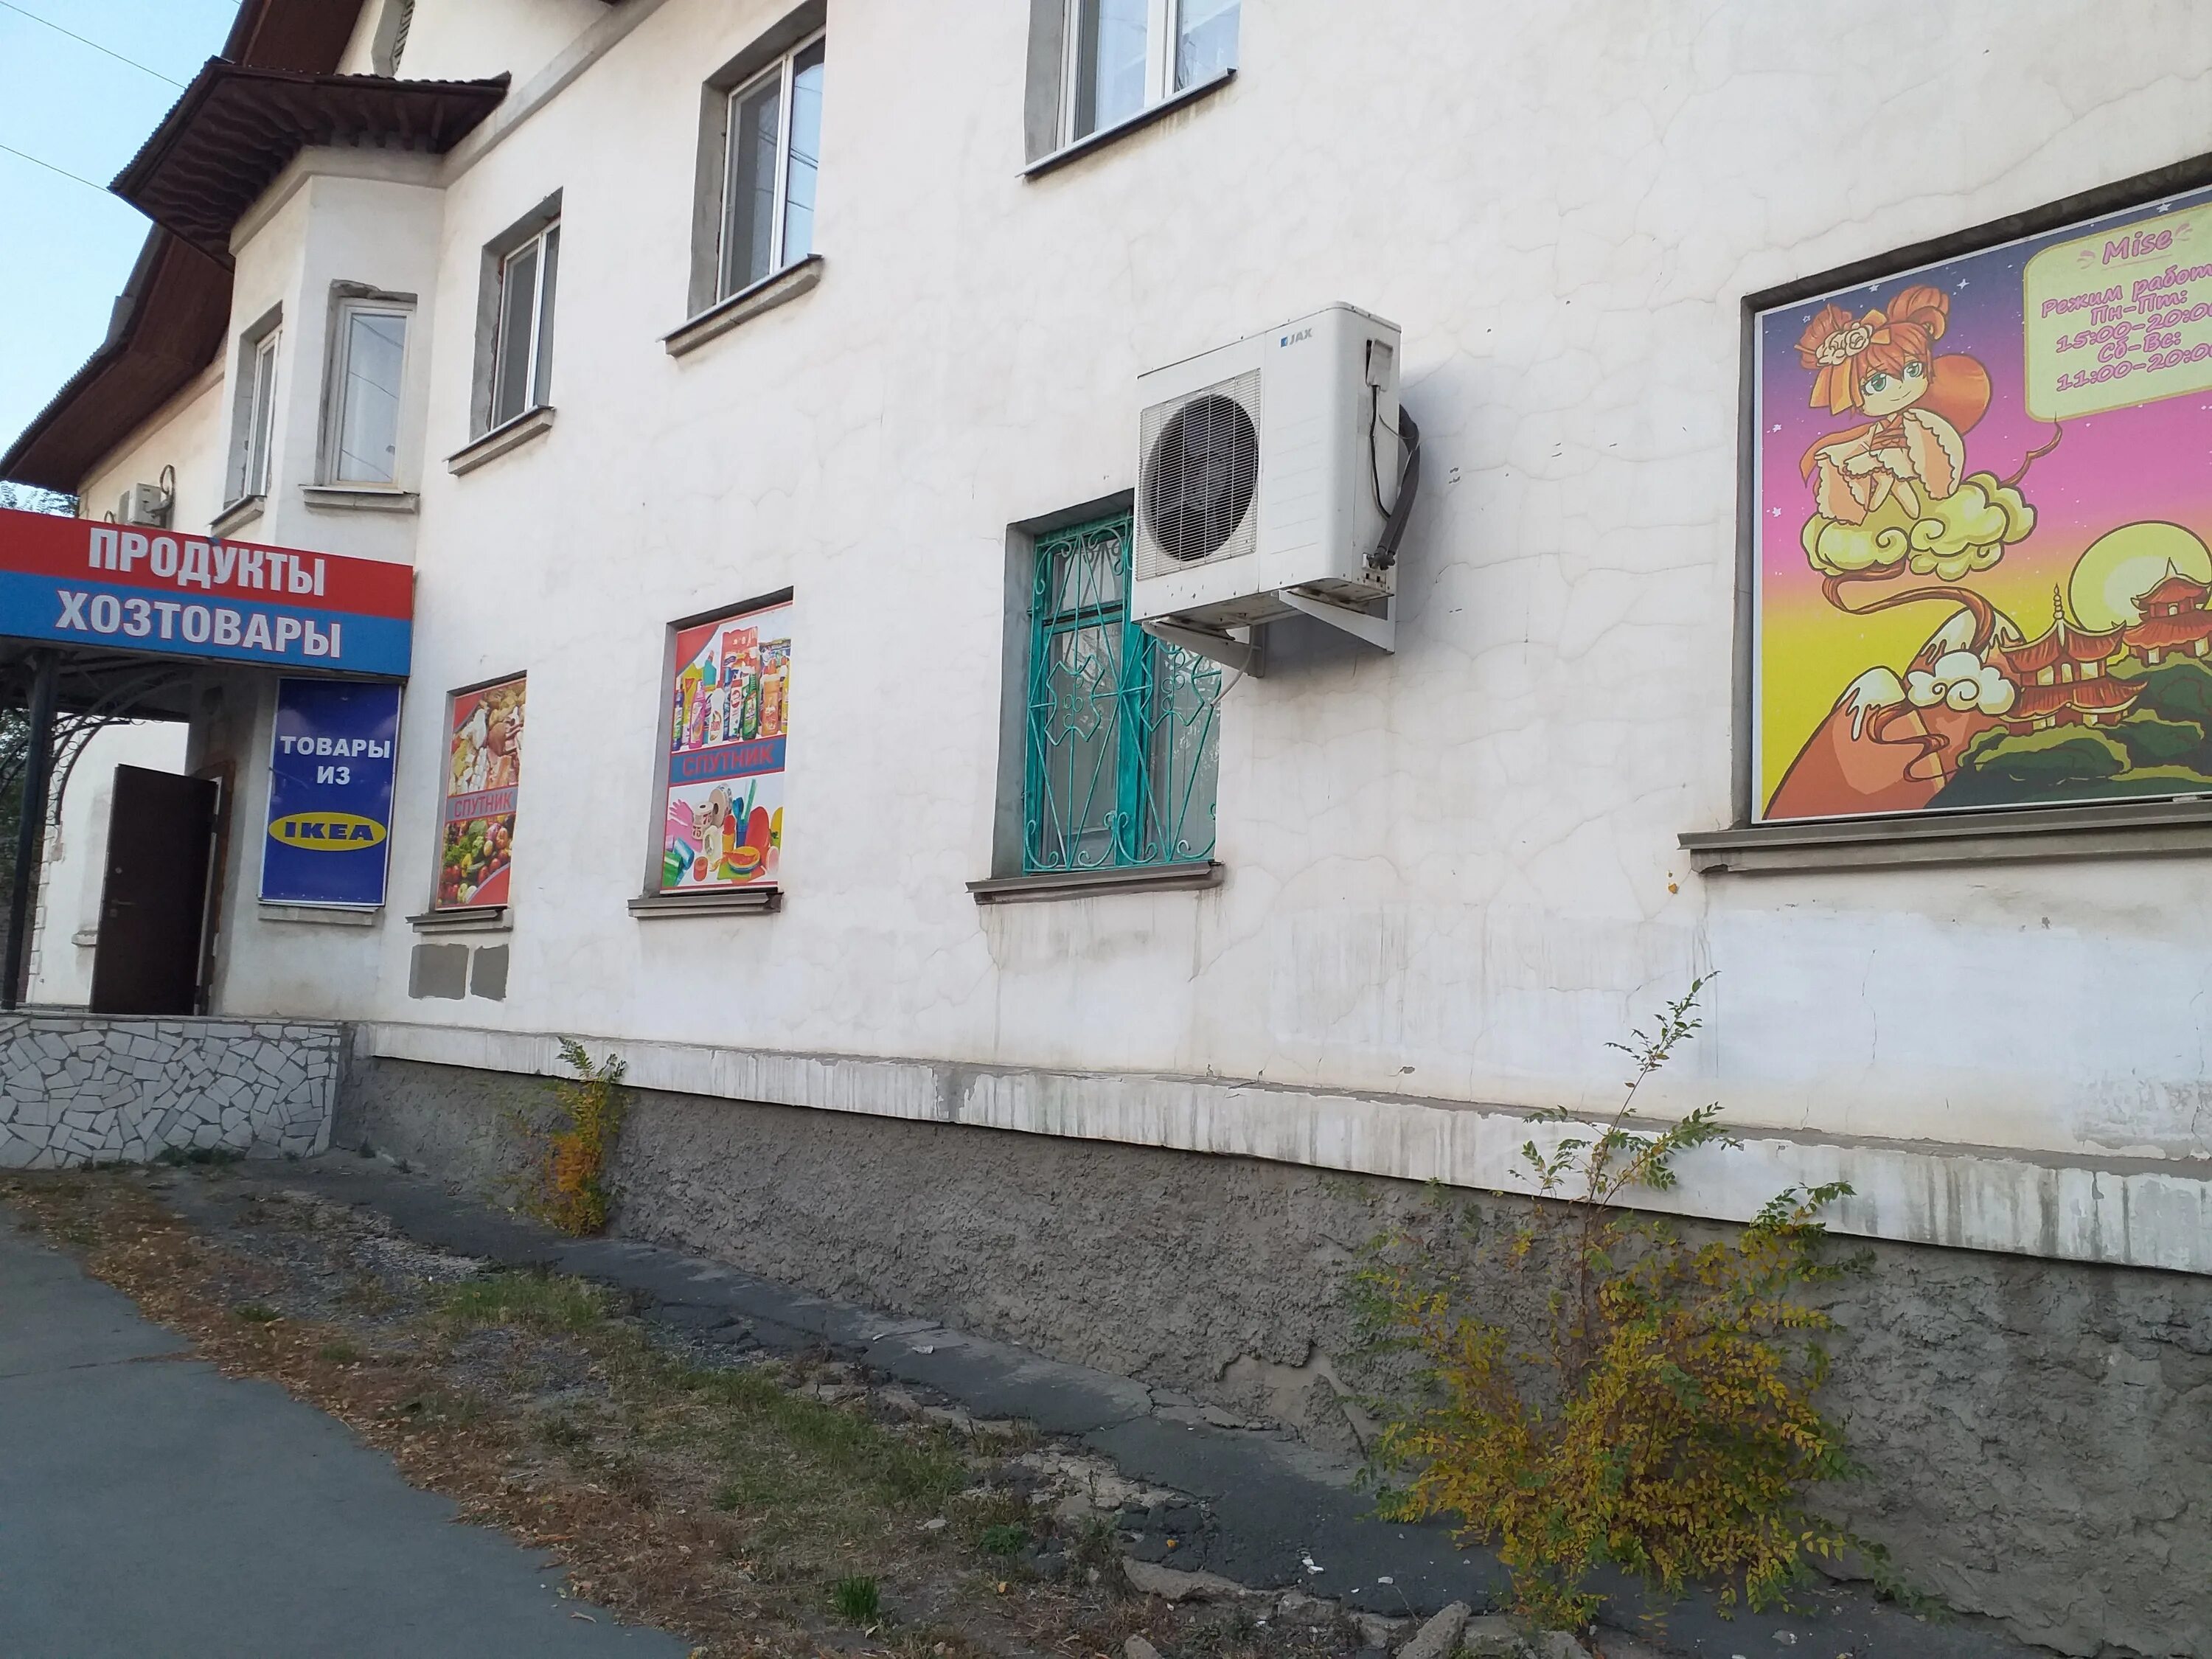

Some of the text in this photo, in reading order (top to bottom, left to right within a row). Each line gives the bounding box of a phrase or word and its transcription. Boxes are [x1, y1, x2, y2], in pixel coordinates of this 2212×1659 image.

[2102, 230, 2173, 265] Mise
[2042, 285, 2124, 319] Режим
[2090, 290, 2188, 326] Пн-Пт:
[1290, 328, 1312, 345] JAX
[2056, 302, 2212, 353] 15:00-20:0
[2098, 332, 2182, 364] Сб-Вс:
[2056, 343, 2212, 392] 11:00-20:0
[88, 527, 325, 597] ПРОДУКТЫ
[55, 591, 341, 658] ХОЗТОВАРЫ
[280, 736, 391, 759] ТОВАРЫ
[683, 744, 774, 776] СПУТНИК
[316, 766, 351, 785] ИЗ
[453, 791, 512, 818] СПУТНИК
[284, 821, 375, 841] IKEA
